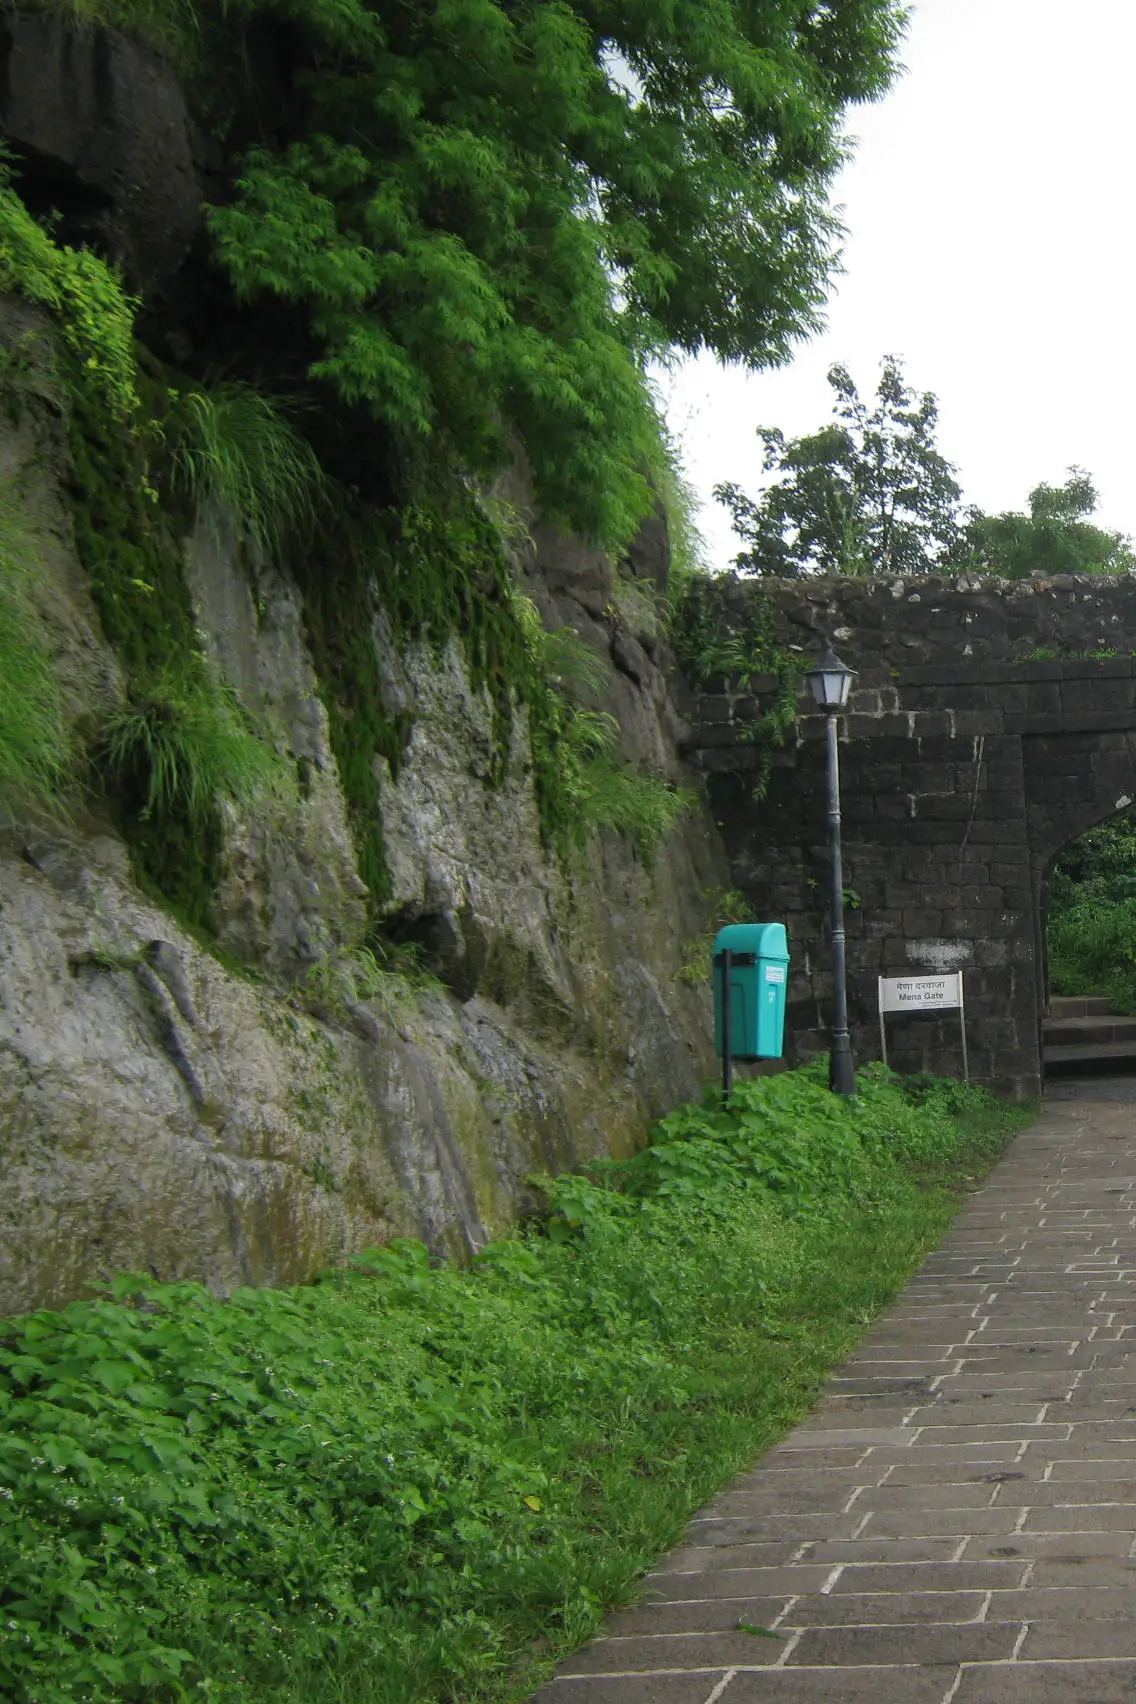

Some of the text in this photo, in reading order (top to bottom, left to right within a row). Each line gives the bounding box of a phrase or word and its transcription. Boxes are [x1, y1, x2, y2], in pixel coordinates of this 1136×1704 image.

[915, 981, 945, 990] दरवाजा
[898, 992, 944, 1001] Mena Gate
